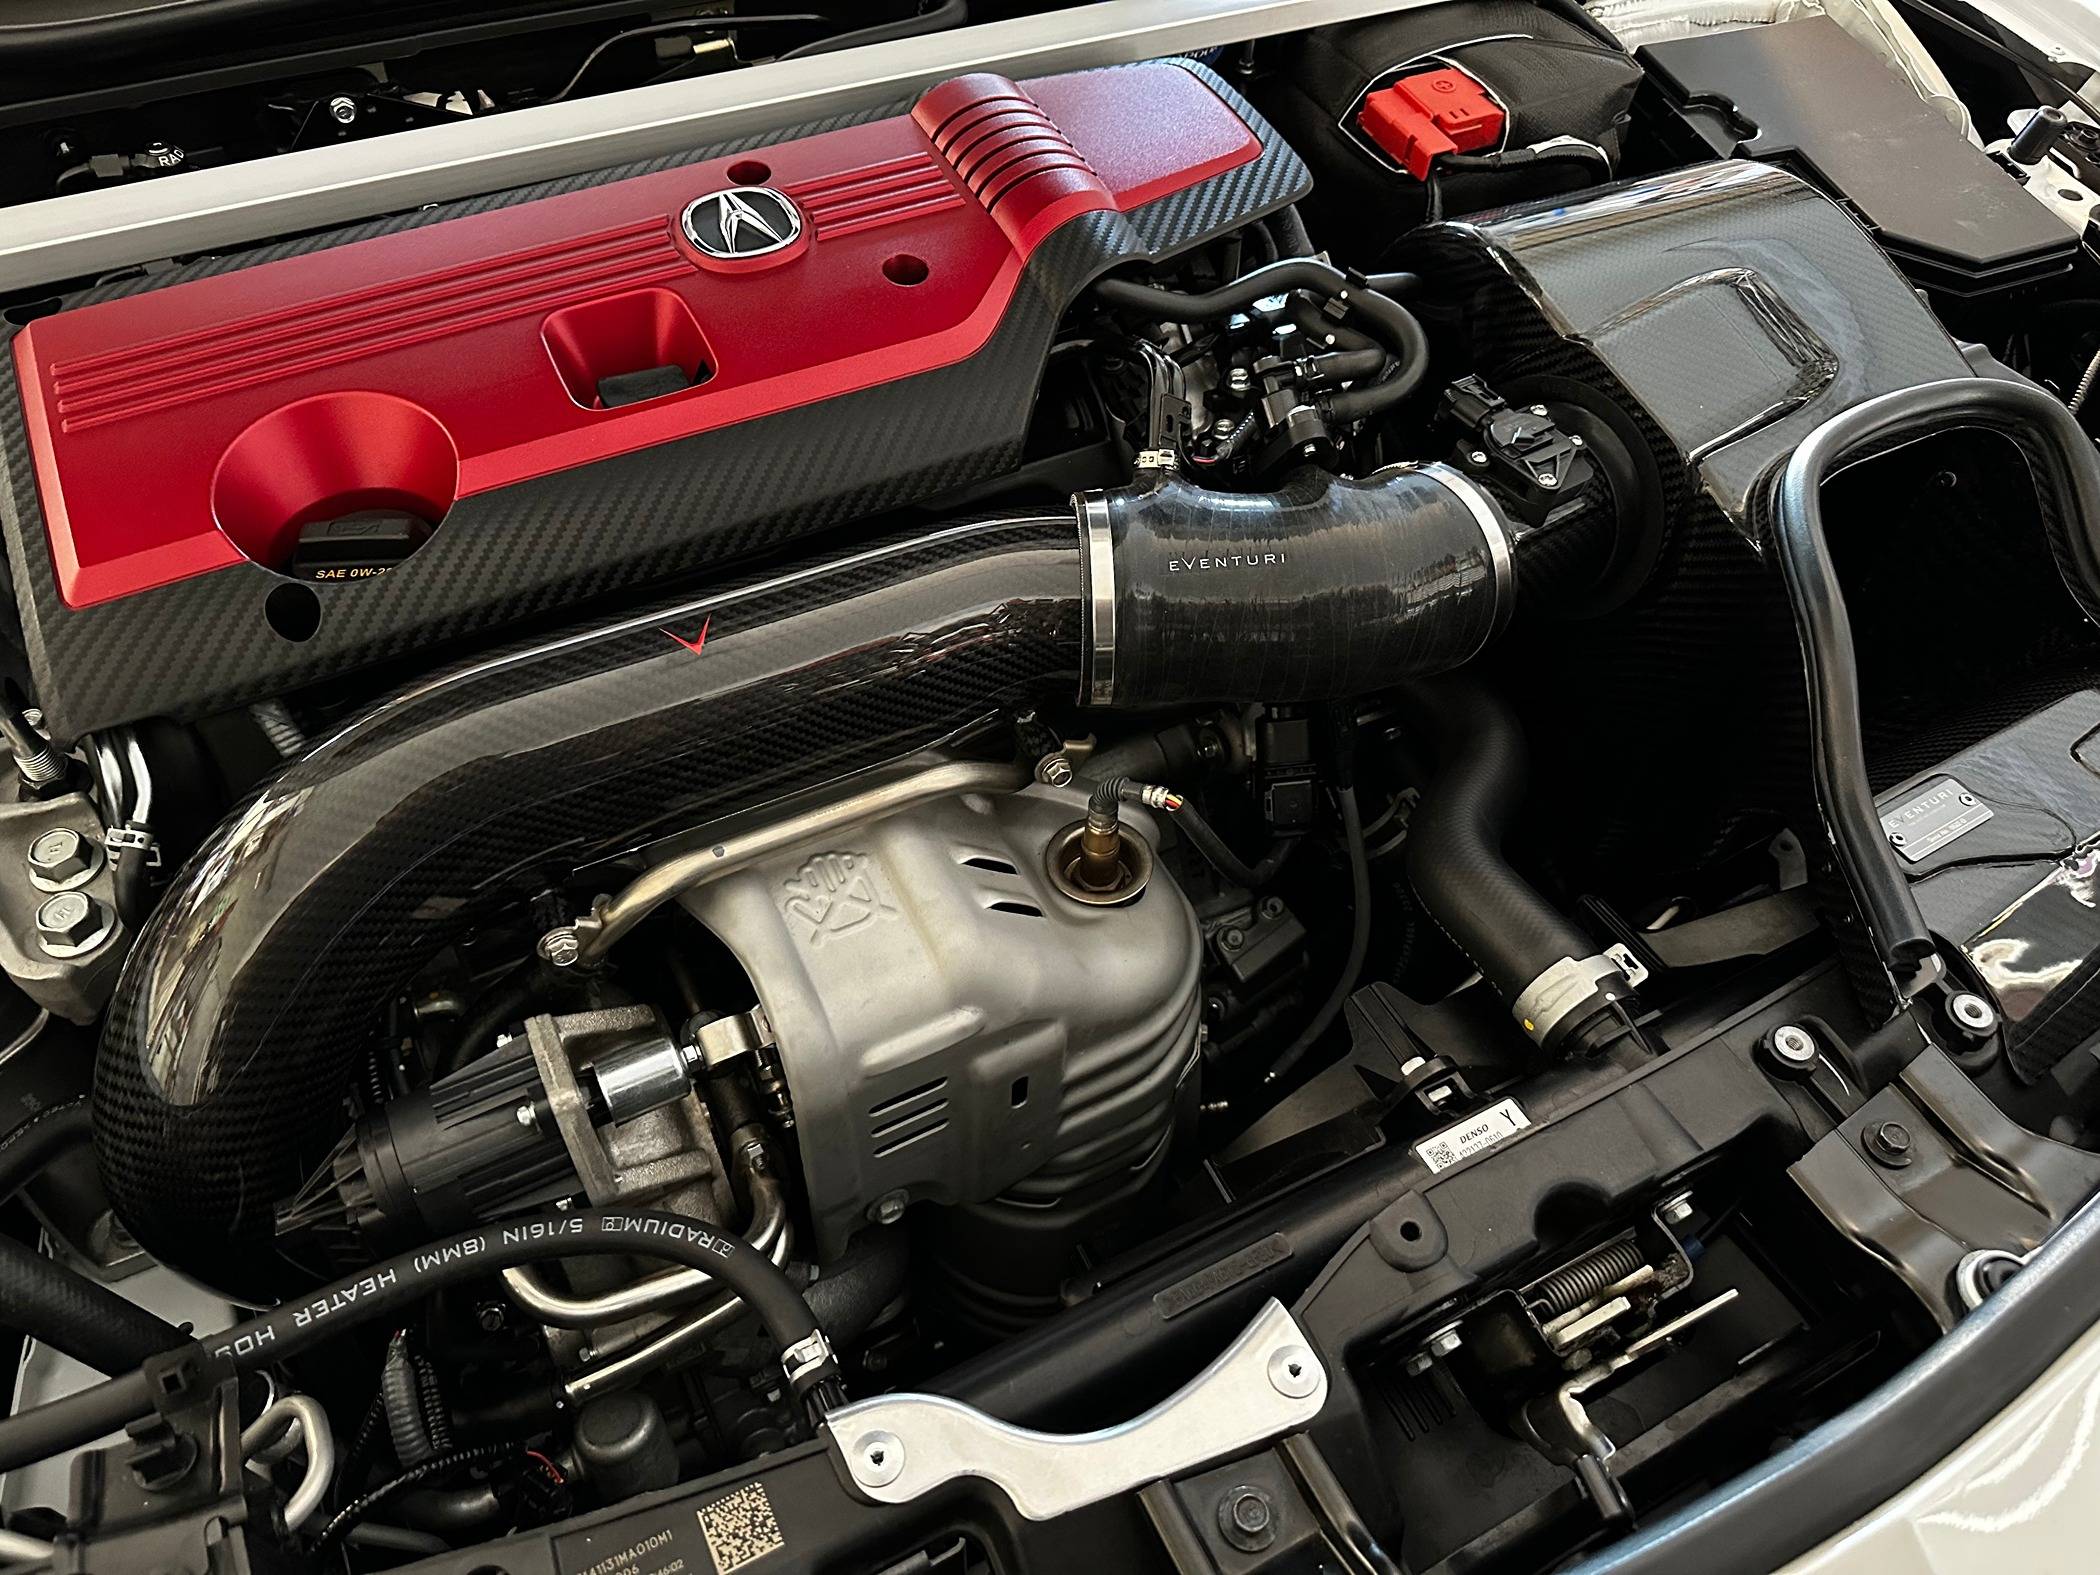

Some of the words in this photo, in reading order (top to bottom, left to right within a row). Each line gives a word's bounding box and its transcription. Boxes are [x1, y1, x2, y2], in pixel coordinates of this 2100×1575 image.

[159, 146, 184, 167] RAD
[315, 568, 347, 579] SAE
[1169, 553, 1286, 572] EVENTURI
[1888, 788, 1955, 829] EVENTURI
[1499, 1108, 1517, 1127] Y
[1460, 1123, 1489, 1144] DENSO
[503, 1217, 584, 1245] 5/16IN
[624, 1217, 715, 1248] RADIUM
[414, 1236, 486, 1273] (8MM)
[292, 1268, 397, 1328] HEATER
[215, 1324, 276, 1359] HOS
